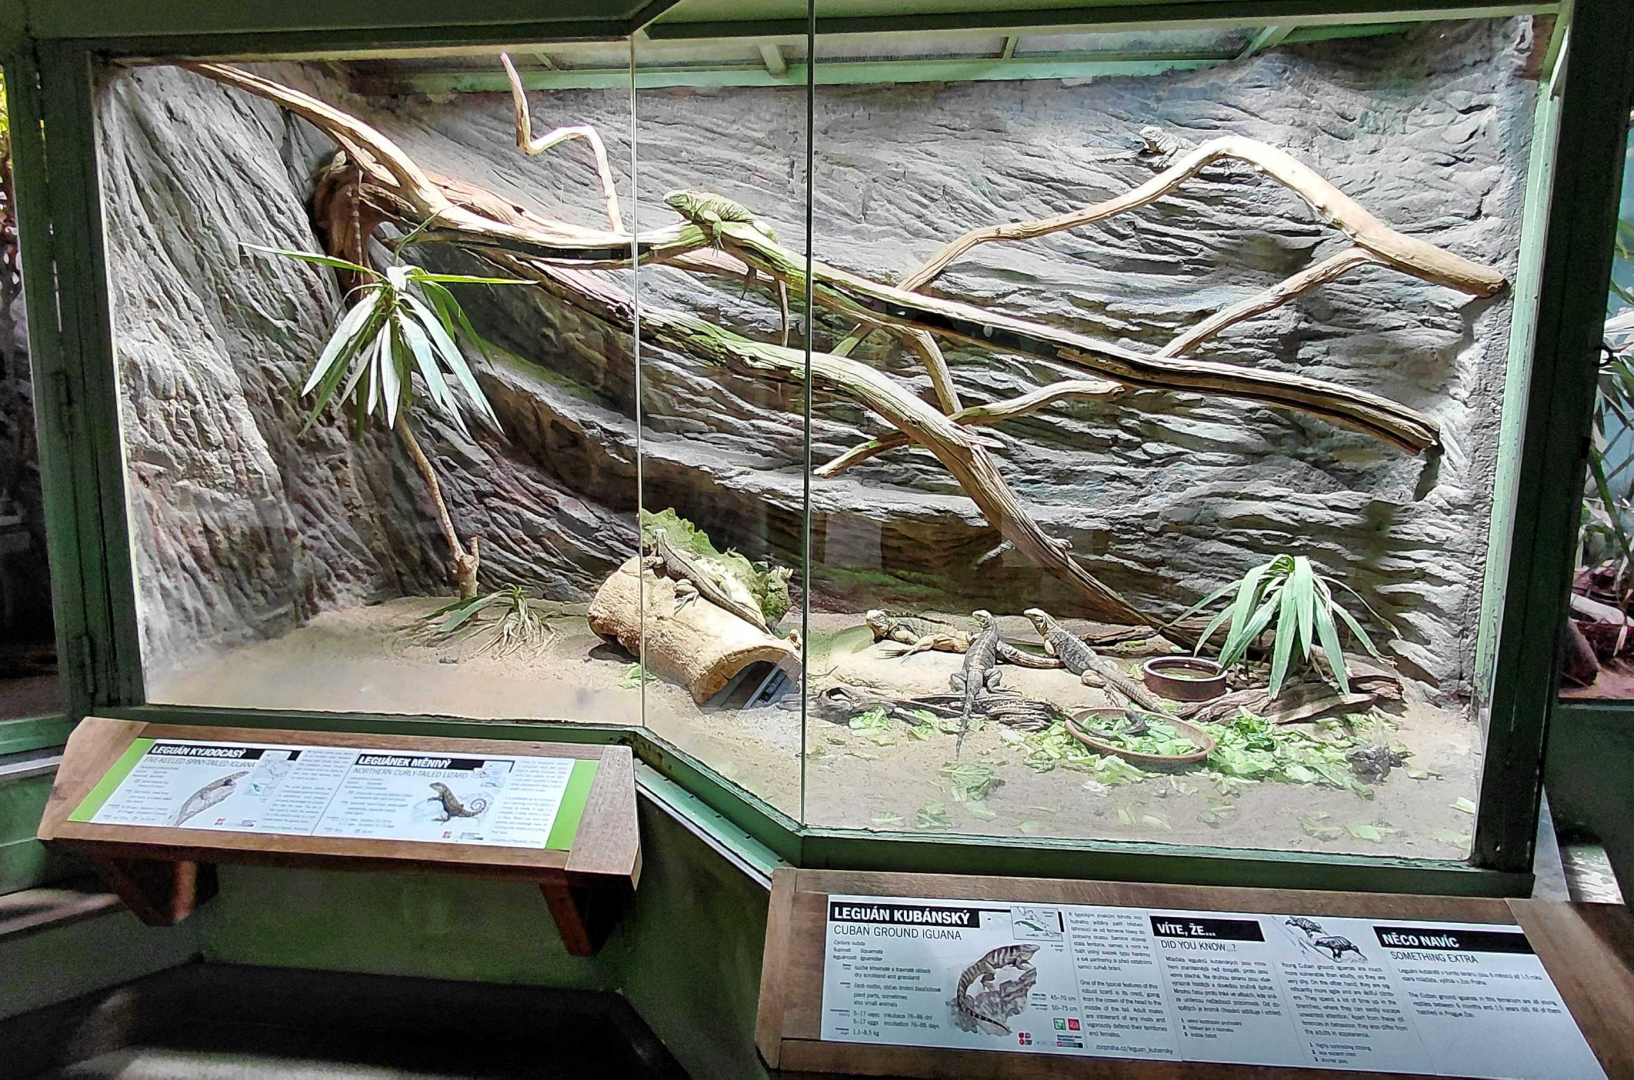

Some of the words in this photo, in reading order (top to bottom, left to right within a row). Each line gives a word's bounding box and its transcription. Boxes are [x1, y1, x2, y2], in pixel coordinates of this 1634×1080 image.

[152, 746, 190, 754] LEGUÁN
[358, 756, 411, 766] LEGUÁNEK
[835, 906, 889, 920] LEGUÁN
[894, 908, 970, 924] KUBÁNSKÝ
[834, 924, 869, 935] CUBAN
[874, 927, 918, 938] GROUND
[923, 929, 962, 940] IGUANA
[1157, 922, 1188, 936] VÍTE,
[1189, 923, 1216, 936] ŽE...
[1161, 940, 1176, 948] DID
[1178, 941, 1196, 949] YOU
[1198, 942, 1225, 951] KNOW
[1382, 932, 1419, 945] NĚCO
[1419, 934, 1459, 947] NAVÍC
[1390, 951, 1446, 962] SOMETHING
[1447, 954, 1478, 963] EXTRA
